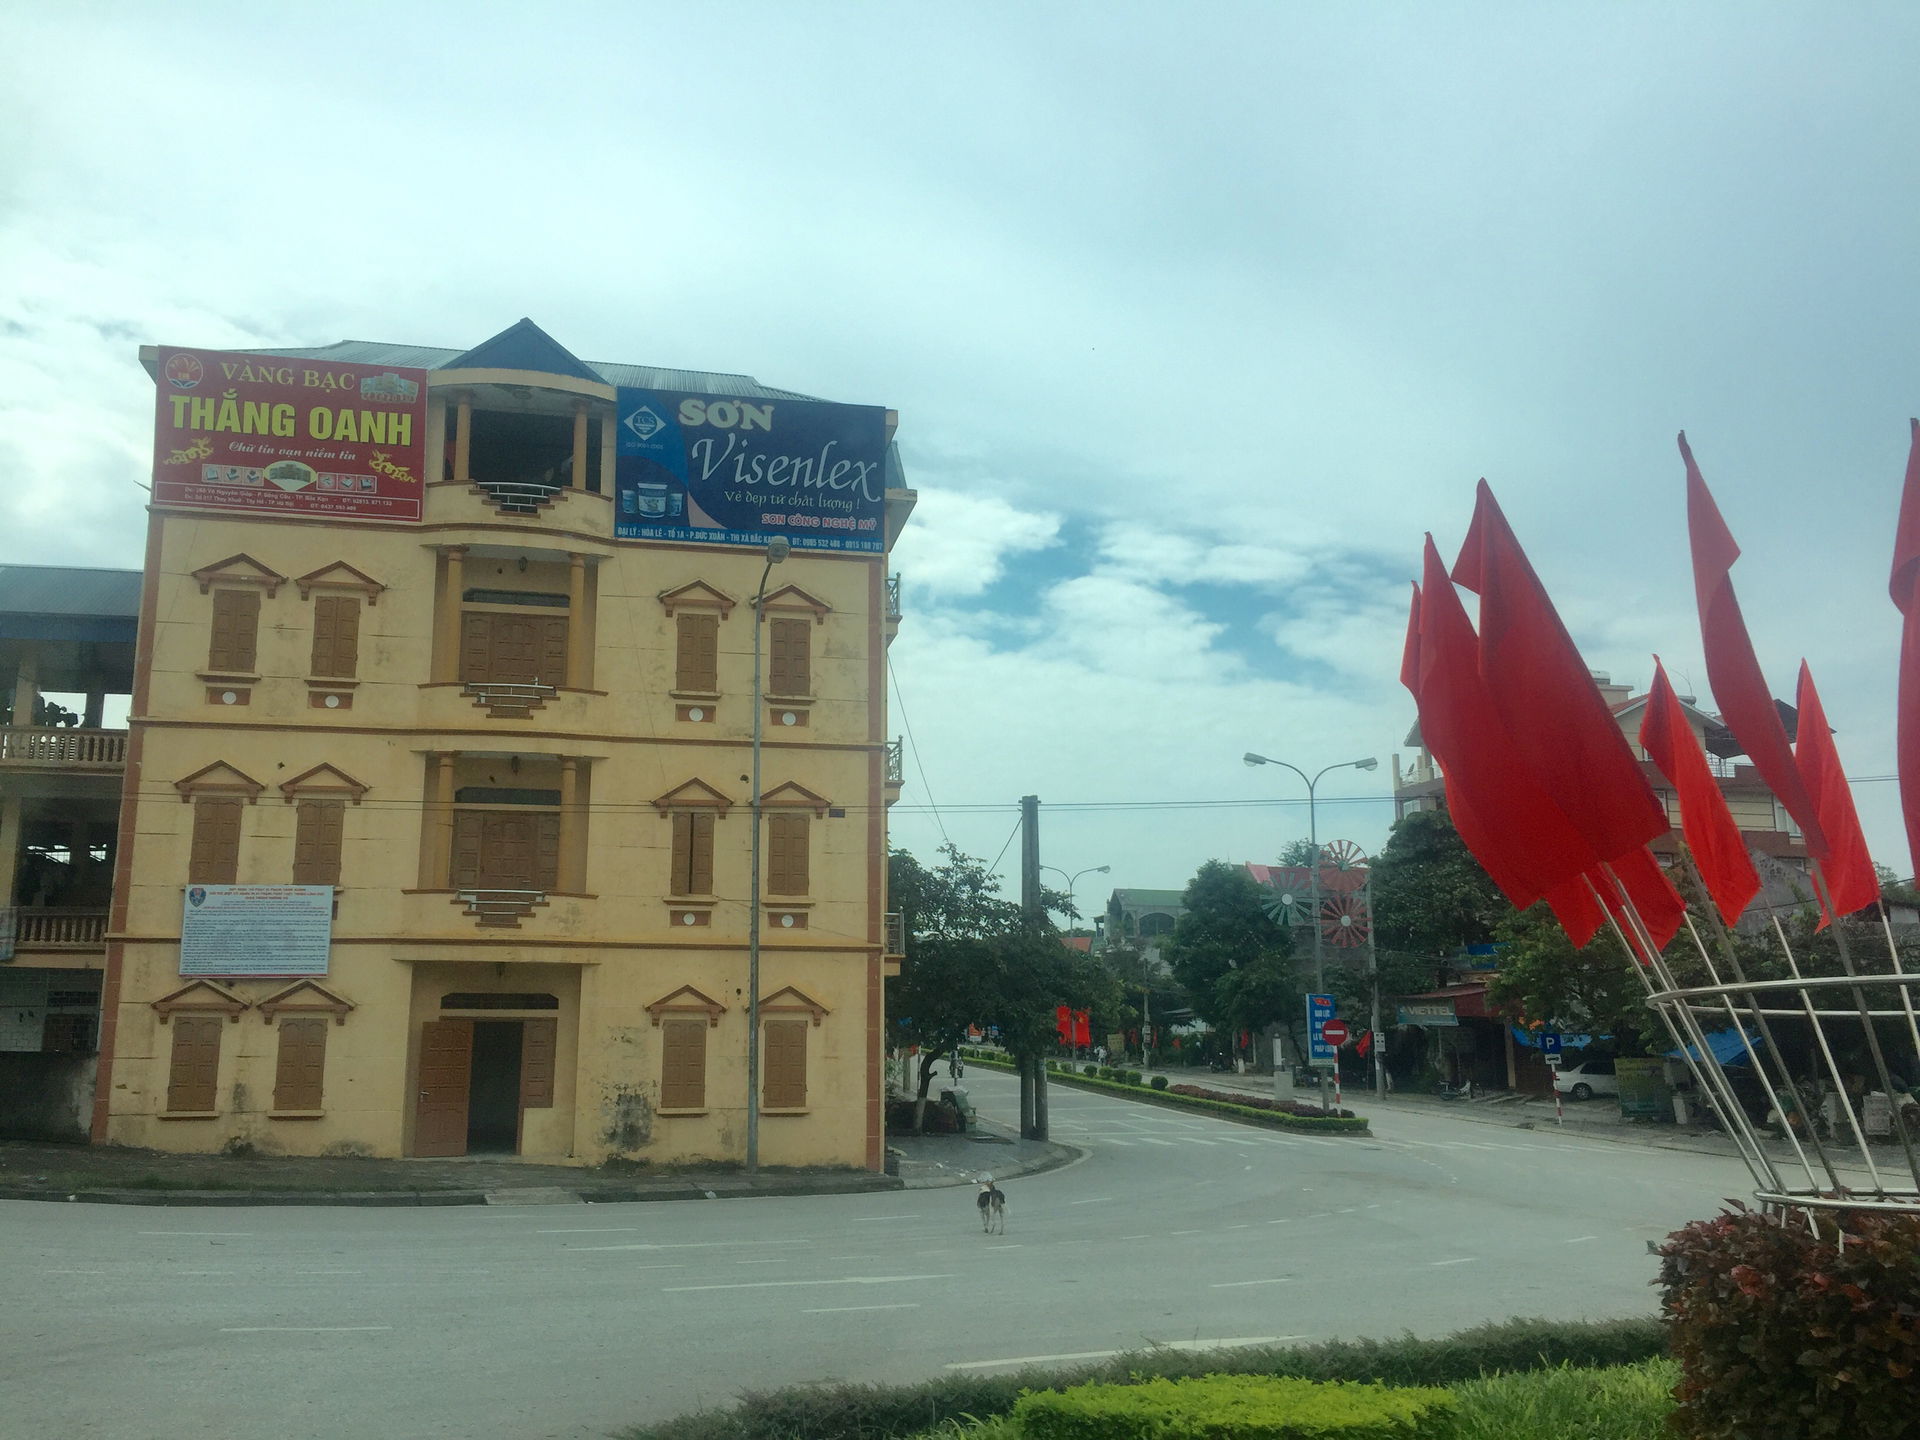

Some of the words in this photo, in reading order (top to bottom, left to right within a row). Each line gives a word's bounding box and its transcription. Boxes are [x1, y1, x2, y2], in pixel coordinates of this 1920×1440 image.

[220, 359, 294, 385] VÀNG
[303, 369, 355, 393] BẠC
[169, 387, 296, 438] THẮNG
[309, 406, 412, 447] OANH
[678, 399, 775, 432] SƠN
[691, 432, 882, 503] Visenlex
[788, 513, 820, 528] CÔNG
[1546, 1037, 1554, 1049] P
